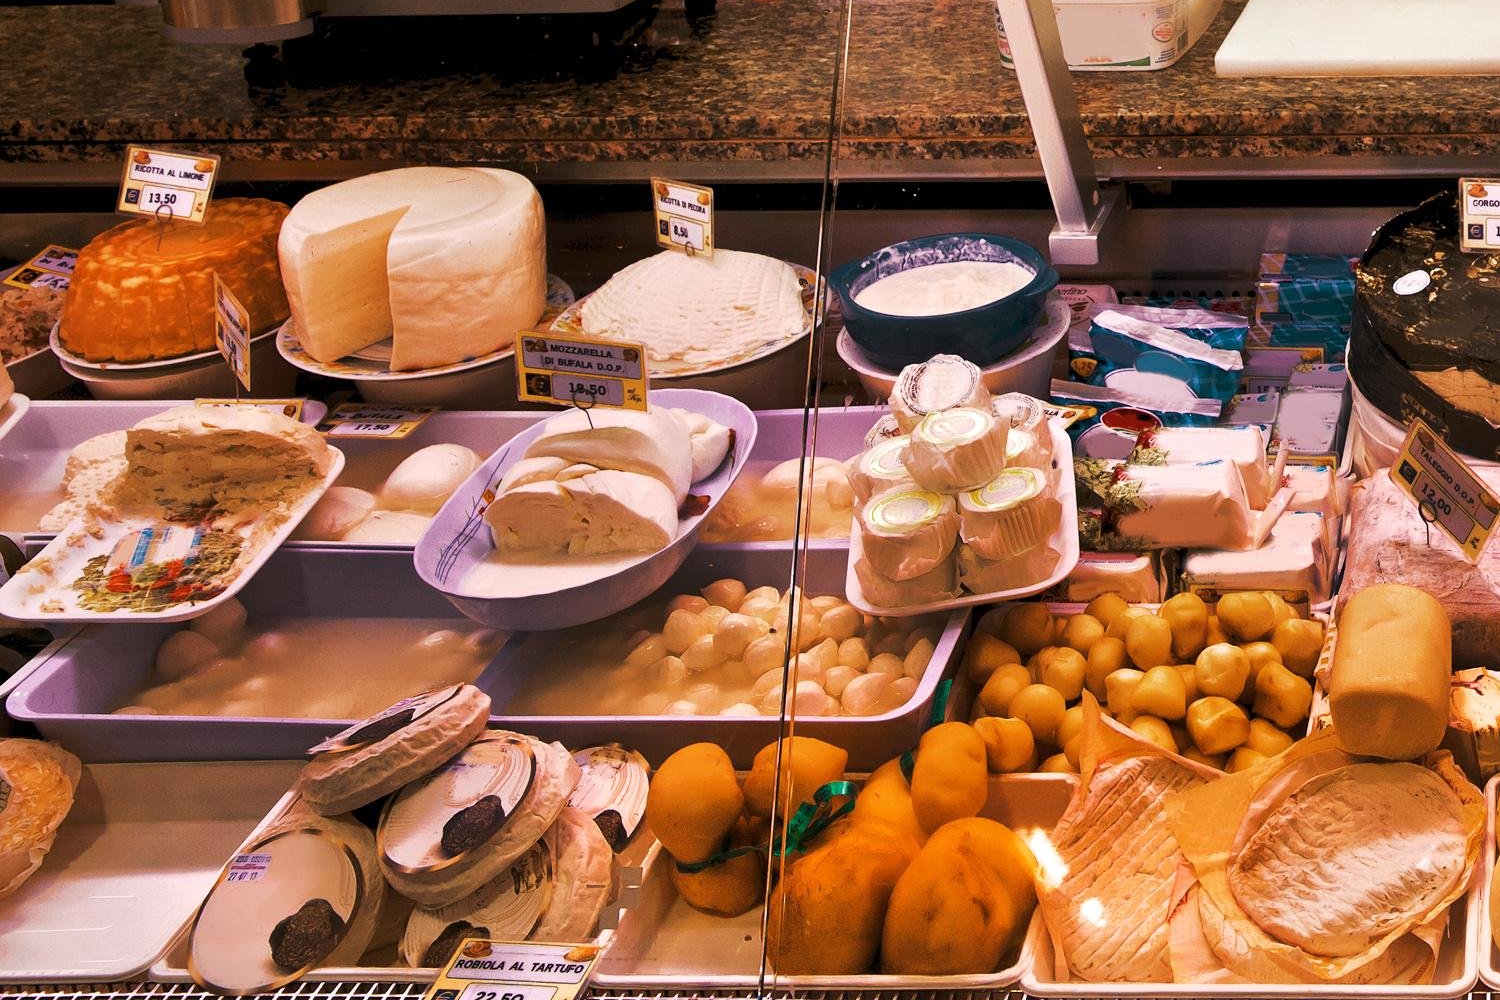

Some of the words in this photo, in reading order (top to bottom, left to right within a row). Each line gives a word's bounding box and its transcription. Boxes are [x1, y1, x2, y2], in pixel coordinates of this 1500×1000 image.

[135, 164, 164, 175] RICOTTA
[179, 171, 205, 181] LIMONE
[688, 202, 706, 214] PECORA
[550, 343, 612, 358] MOZZARELLA
[544, 356, 554, 365] DI
[558, 358, 593, 370] BUFALA
[1420, 447, 1453, 484] TALEGGIO
[455, 959, 504, 971] ROBIOLA
[509, 961, 524, 971] AL
[531, 962, 584, 974] TARTUFO
